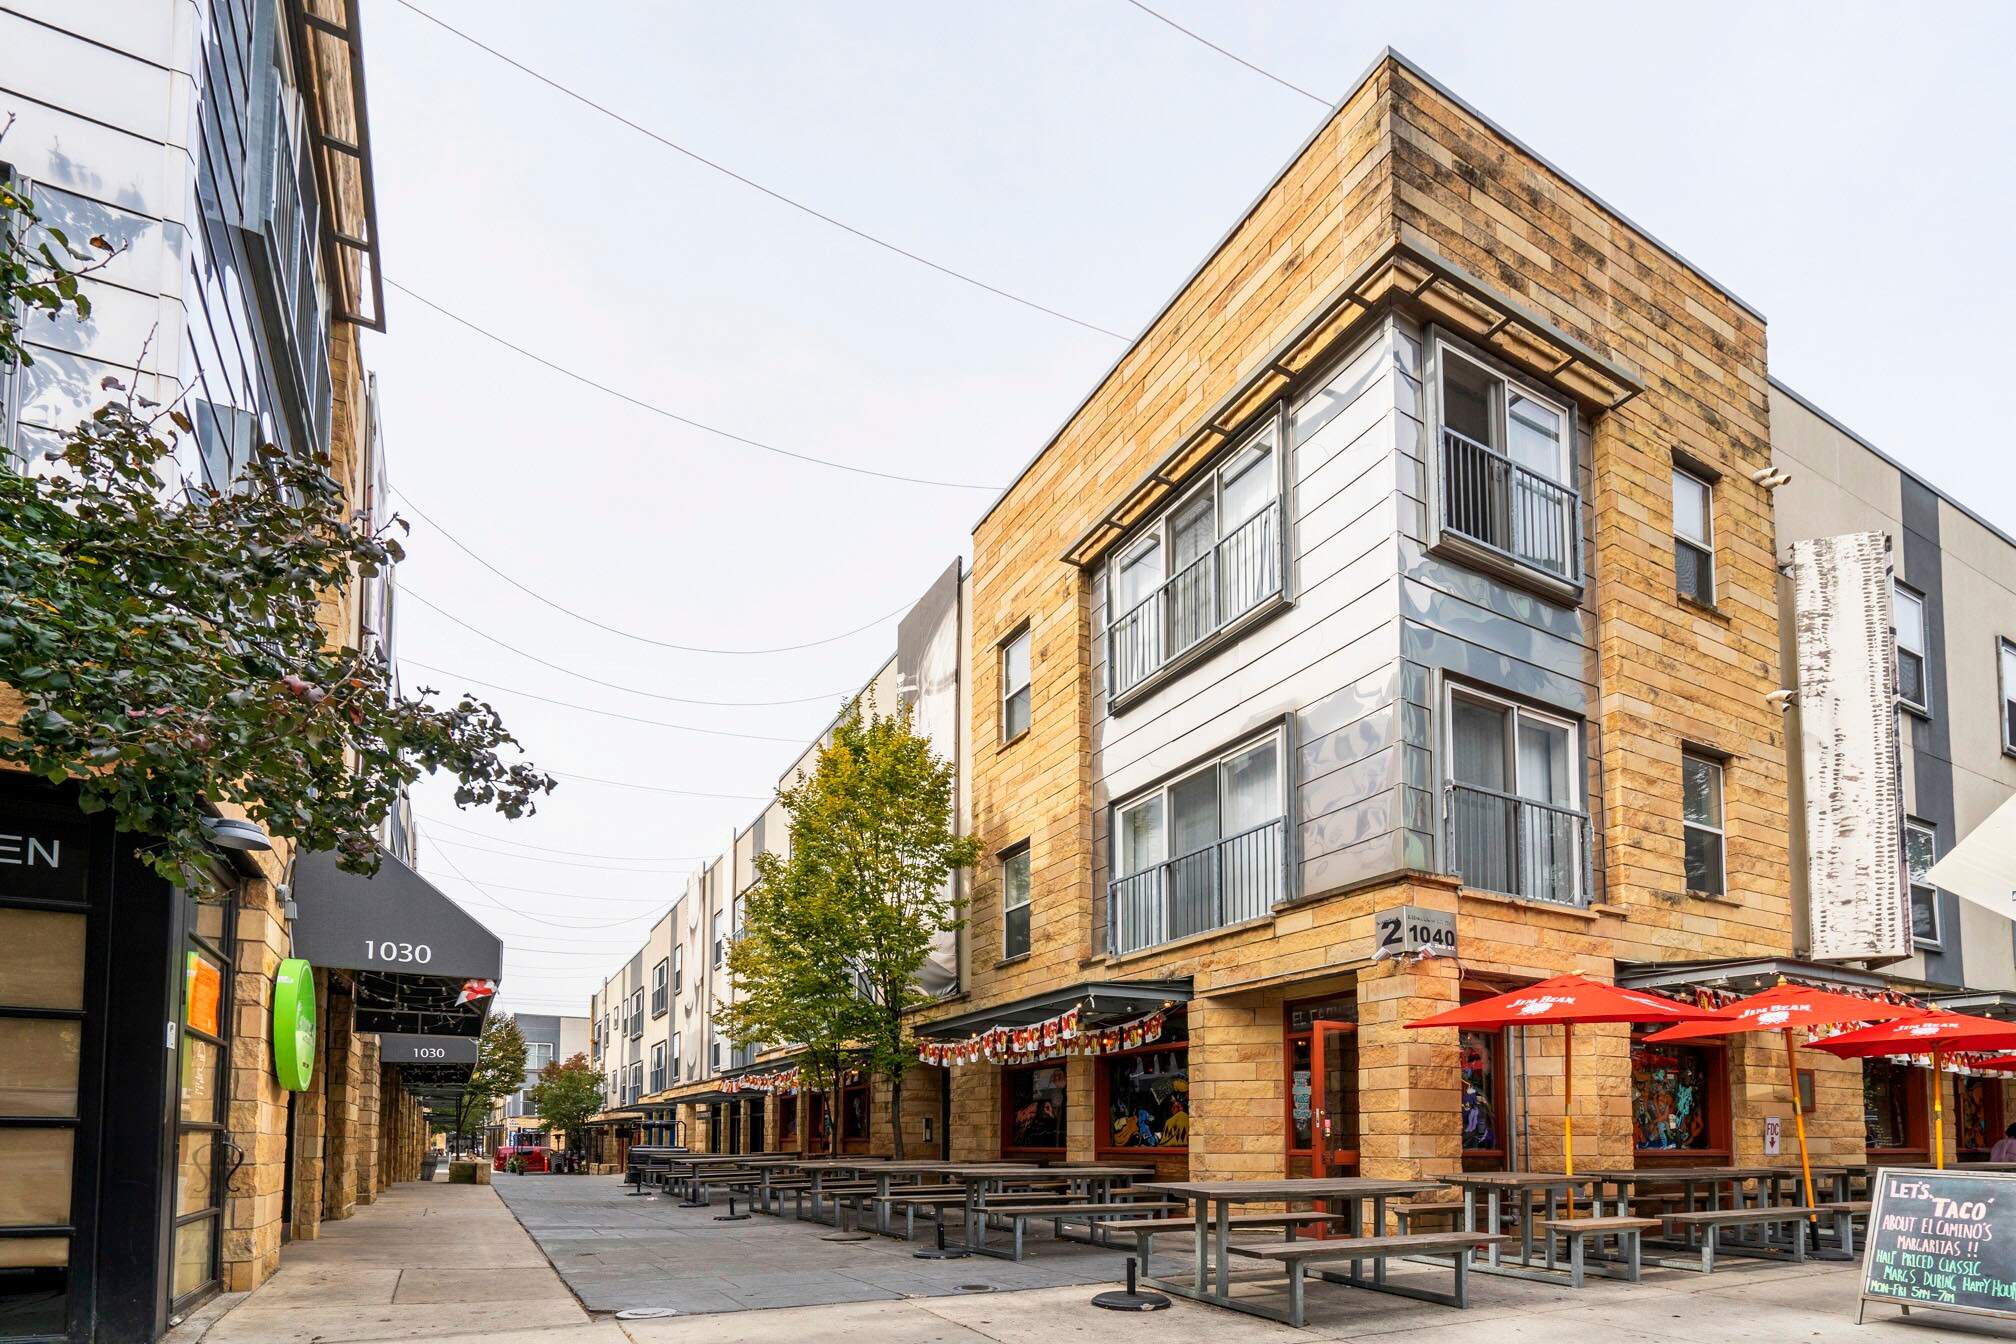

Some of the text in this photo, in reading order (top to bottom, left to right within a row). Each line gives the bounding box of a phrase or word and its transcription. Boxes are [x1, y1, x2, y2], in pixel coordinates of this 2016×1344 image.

[1381, 918, 1403, 947] 2
[1409, 924, 1455, 947] 1040
[365, 940, 432, 964] 1030
[1505, 995, 1577, 1009] JIM BEAM
[1738, 1003, 1812, 1019] JIM BEAM
[1893, 1023, 1922, 1032] JIM
[413, 1048, 445, 1058] 1030
[1766, 1122, 1780, 1136] FDC
[1881, 1214, 1993, 1242] ABOUT EL CAMINO'S
[1896, 1235, 1961, 1257] MARGARITAS
[1876, 1249, 1982, 1276] HALF PRICED CLASSIC
[1870, 1279, 1907, 1298] MON-FRI
[1923, 1271, 1957, 1292] DURING
[1962, 1276, 1992, 1294] HAPPY
